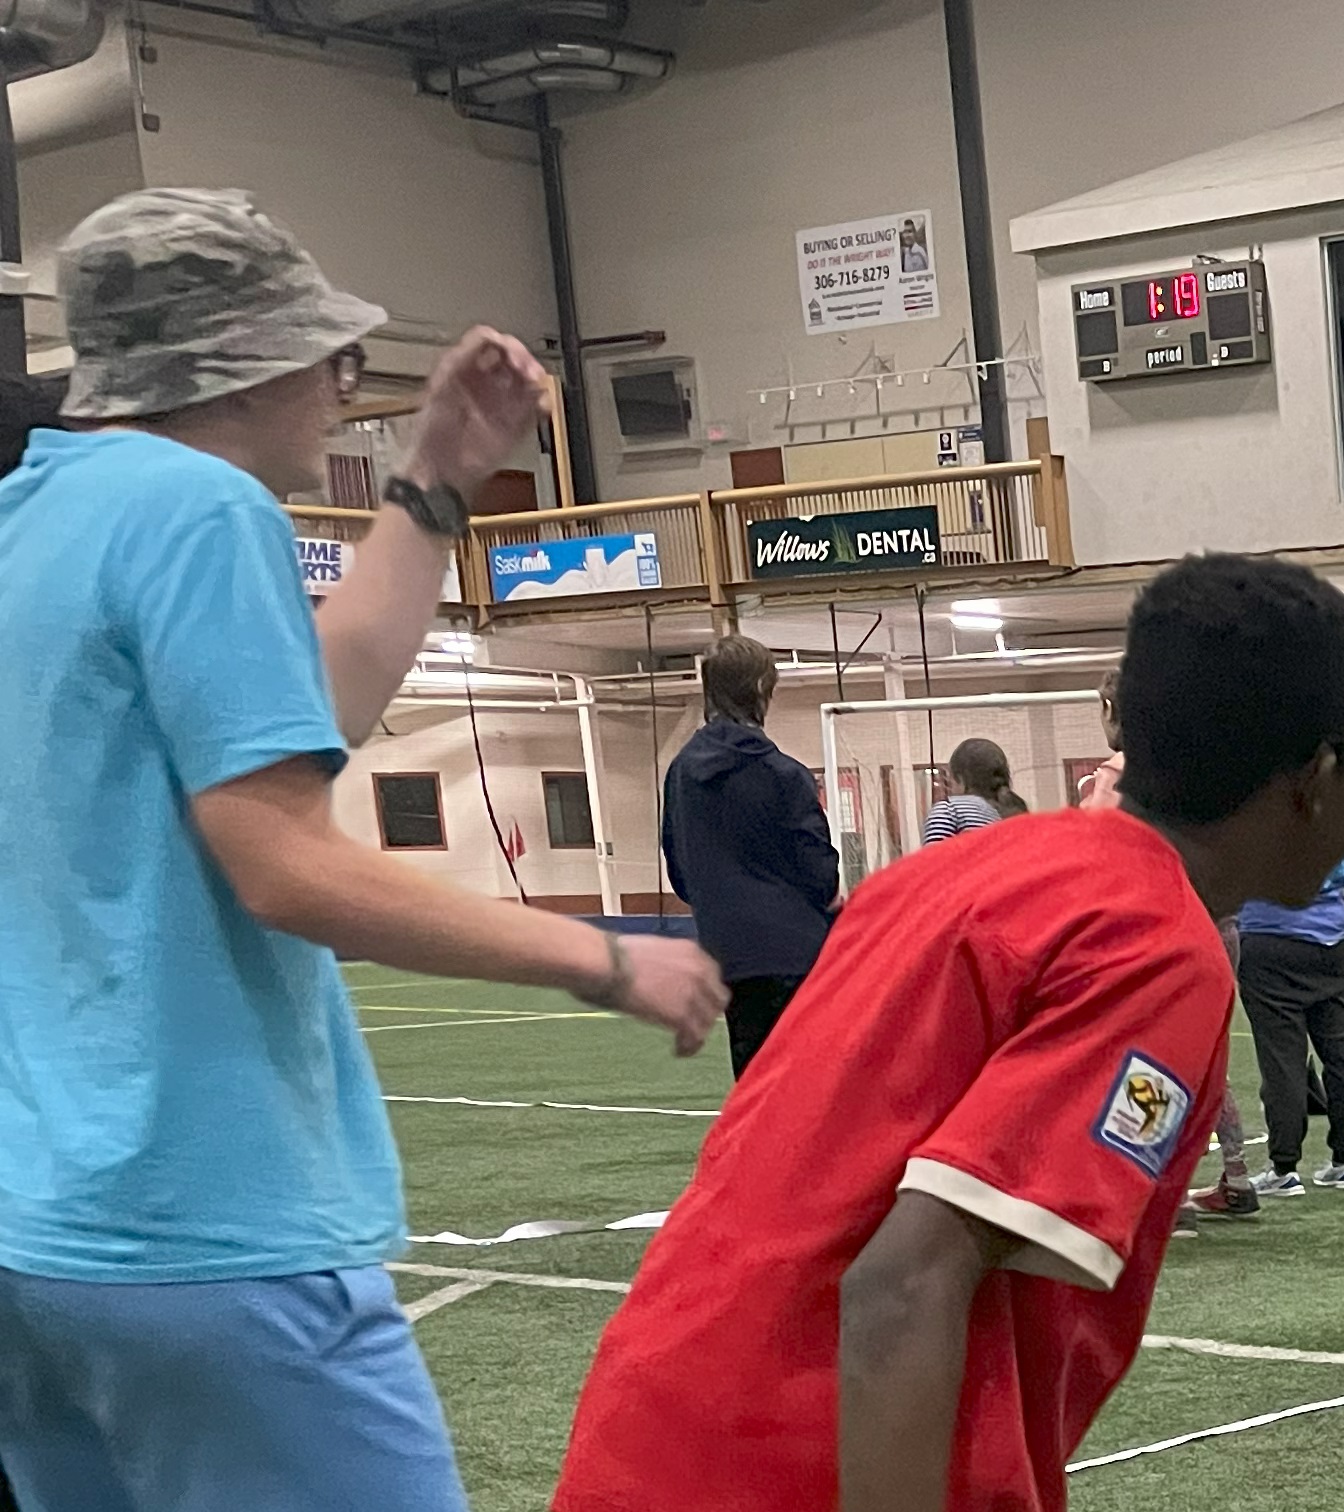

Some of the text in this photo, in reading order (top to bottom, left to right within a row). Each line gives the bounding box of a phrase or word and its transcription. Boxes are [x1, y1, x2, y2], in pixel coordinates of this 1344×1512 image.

[803, 227, 897, 254] BUYING OR SELLING?
[814, 265, 890, 290] 306-716-8279
[1206, 270, 1246, 292] Guests
[1079, 289, 1110, 310] Home
[1149, 273, 1199, 320] 1:19
[1147, 346, 1183, 369] period
[756, 527, 936, 568] Willows DENTAL
[921, 552, 936, 564] .ca
